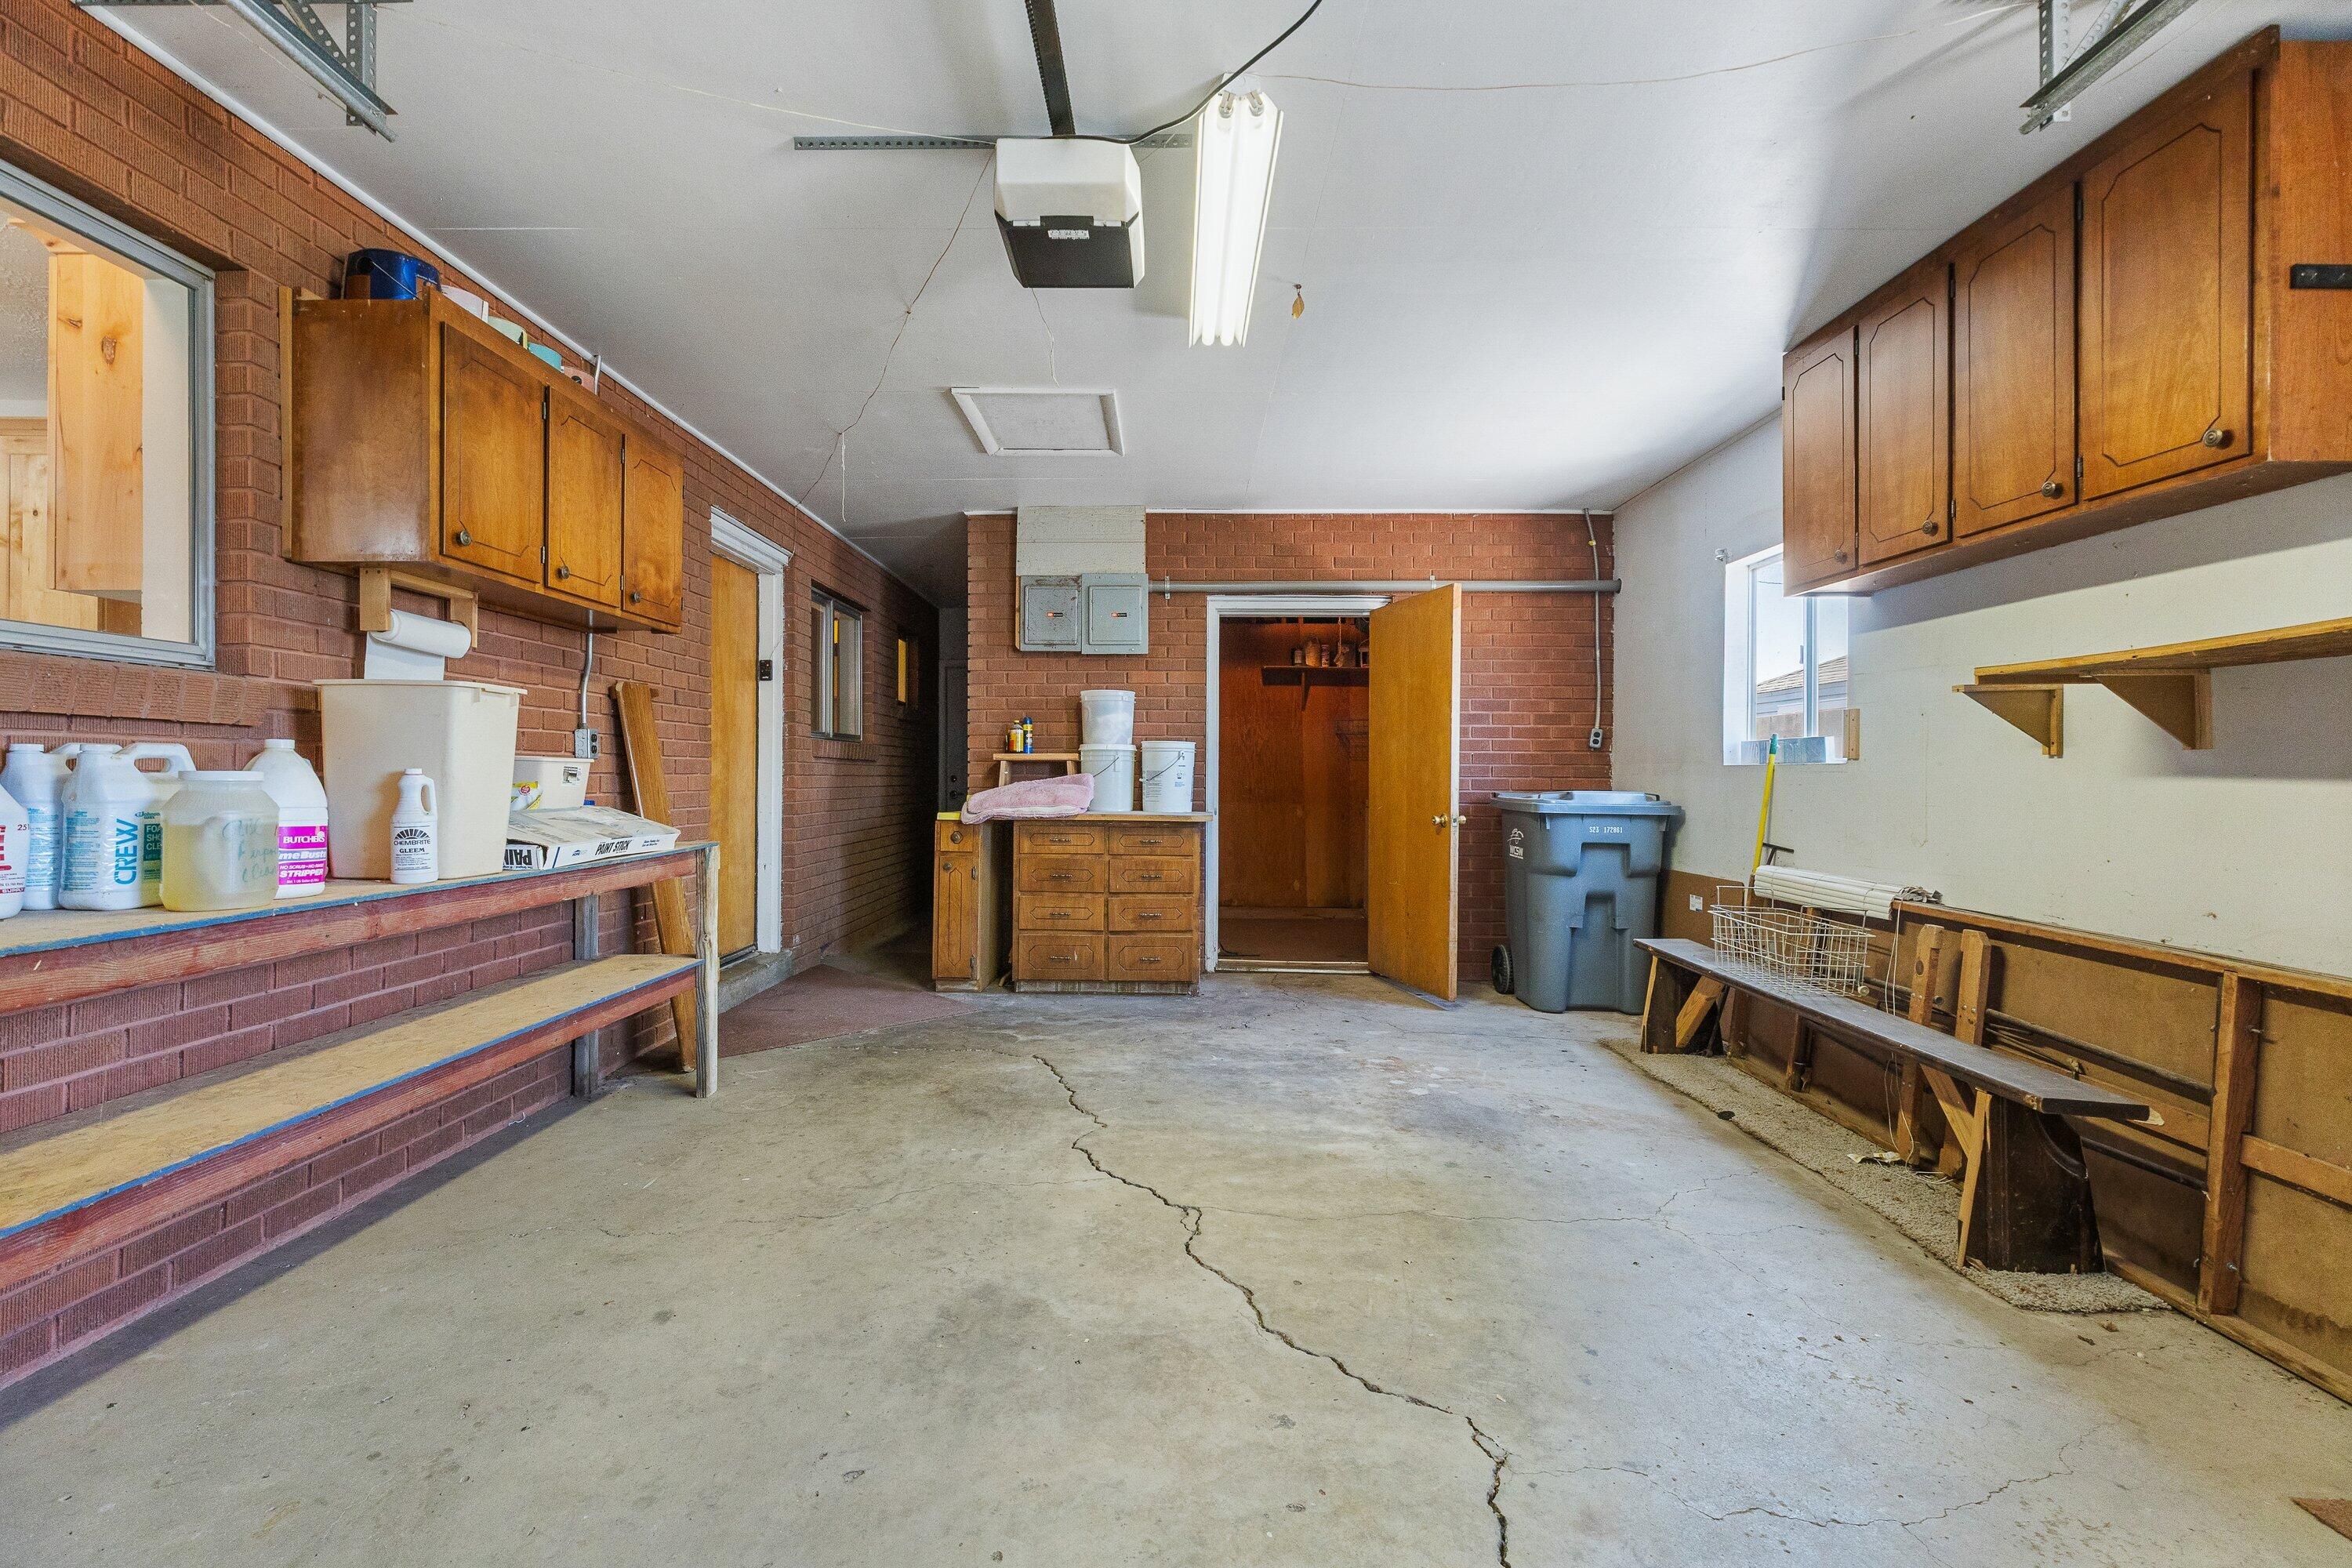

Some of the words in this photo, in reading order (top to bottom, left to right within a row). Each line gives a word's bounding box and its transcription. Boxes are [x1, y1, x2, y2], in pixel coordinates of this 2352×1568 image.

[114, 818, 138, 885] CREW
[595, 842, 615, 856] PAINT
[613, 839, 633, 852] STICK
[279, 868, 324, 878] STRIPPER
